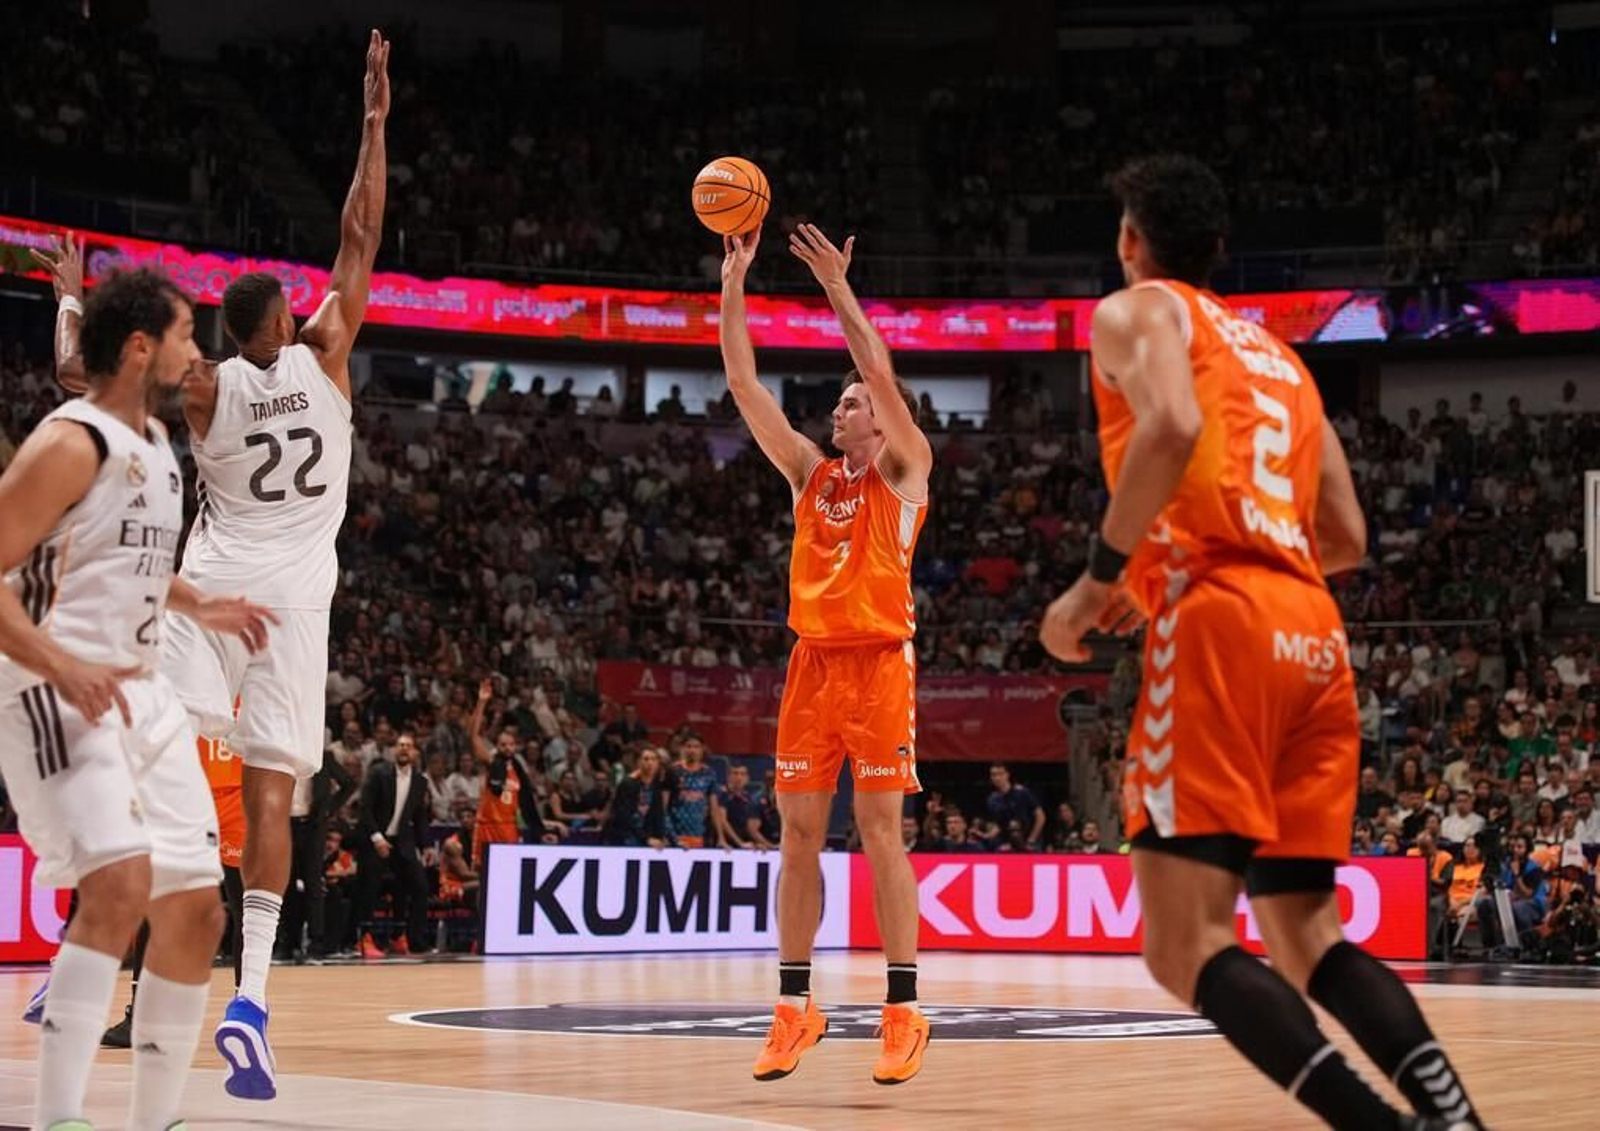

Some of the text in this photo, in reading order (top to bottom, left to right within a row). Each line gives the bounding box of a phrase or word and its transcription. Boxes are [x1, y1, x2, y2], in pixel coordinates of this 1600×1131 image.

[244, 427, 328, 502] 22
[1252, 387, 1294, 503] 2
[1273, 630, 1336, 672] MGS
[859, 764, 896, 777] Midea
[518, 858, 826, 936] KUMH
